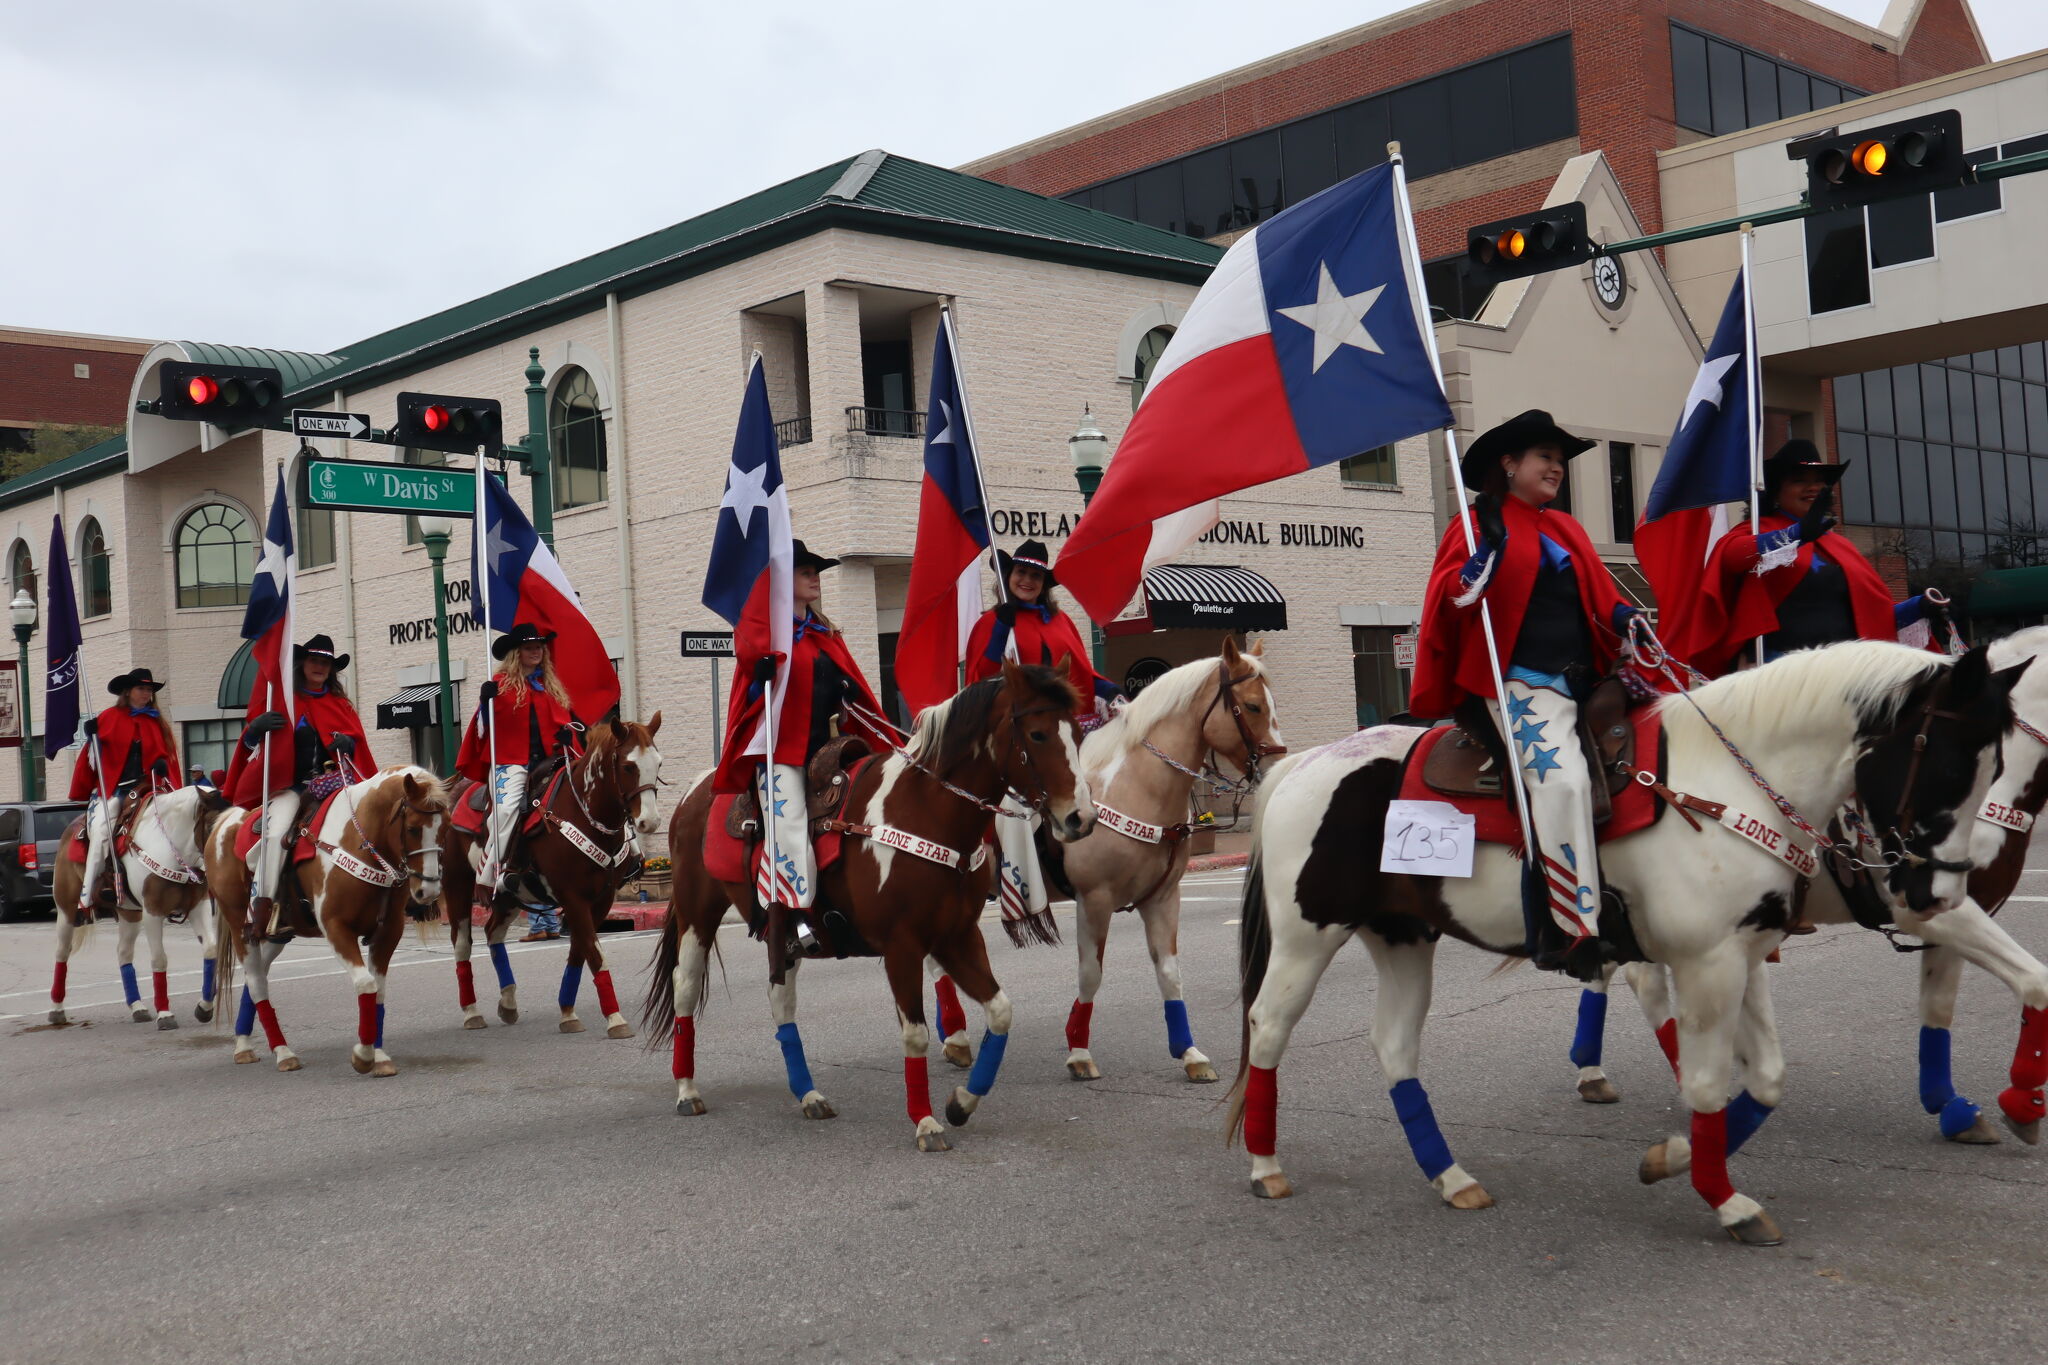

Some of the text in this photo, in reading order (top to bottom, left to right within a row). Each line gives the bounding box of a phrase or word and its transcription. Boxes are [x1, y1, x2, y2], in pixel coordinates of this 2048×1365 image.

[302, 418, 348, 431] ONE WAY
[321, 489, 337, 500] 300
[363, 472, 455, 501] W Davis St
[1280, 523, 1364, 548] BUILDING
[1192, 602, 1222, 616] Paulette
[688, 639, 731, 650] ONE WAY
[1985, 802, 2024, 827] STAR
[1124, 820, 1155, 840] STAR
[1391, 822, 1460, 862] 135
[564, 826, 586, 847] LONE
[586, 845, 607, 863] STAR
[879, 828, 950, 863] LONE STAR
[1733, 813, 1816, 874] LONE STAR
[143, 855, 183, 881] LONE STAR
[335, 853, 387, 885] LONE STAR
